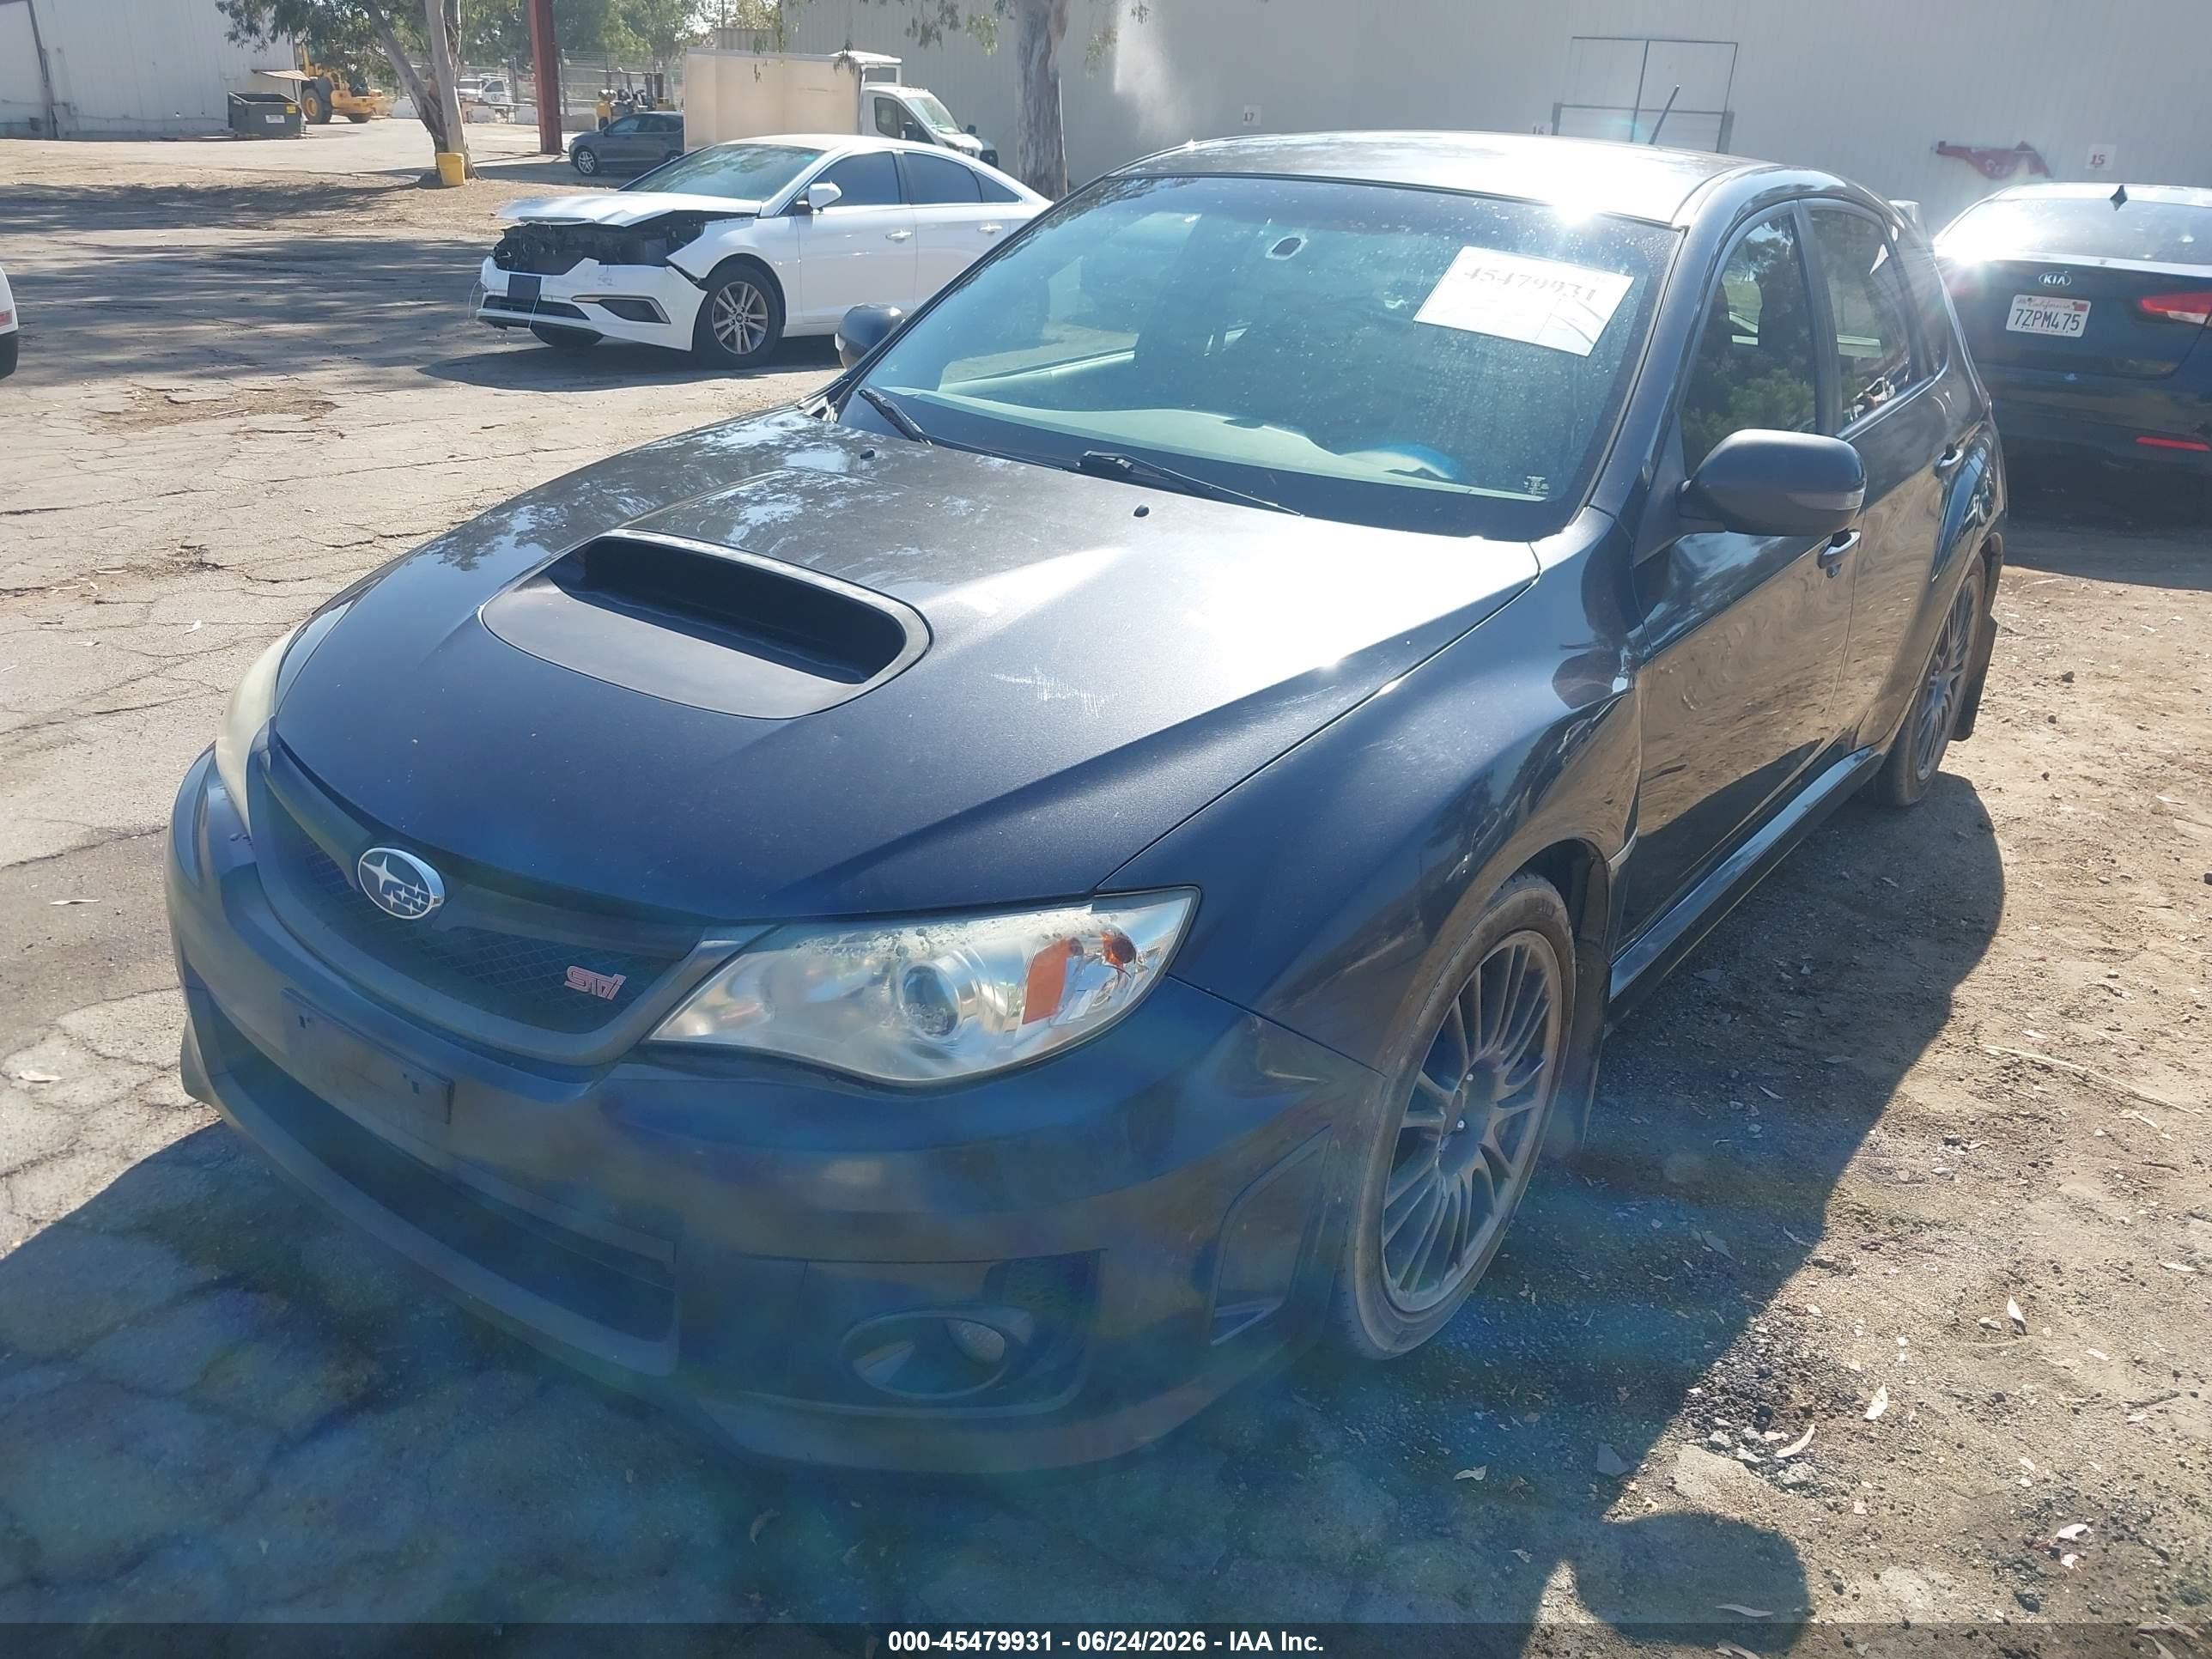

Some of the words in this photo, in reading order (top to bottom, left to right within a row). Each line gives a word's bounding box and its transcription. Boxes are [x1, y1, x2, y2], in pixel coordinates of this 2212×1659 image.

[2090, 154, 2106, 166] 15
[1462, 266, 1598, 303] 45479931
[2043, 274, 2067, 285] KIA
[2014, 308, 2082, 332] 7ZPM475
